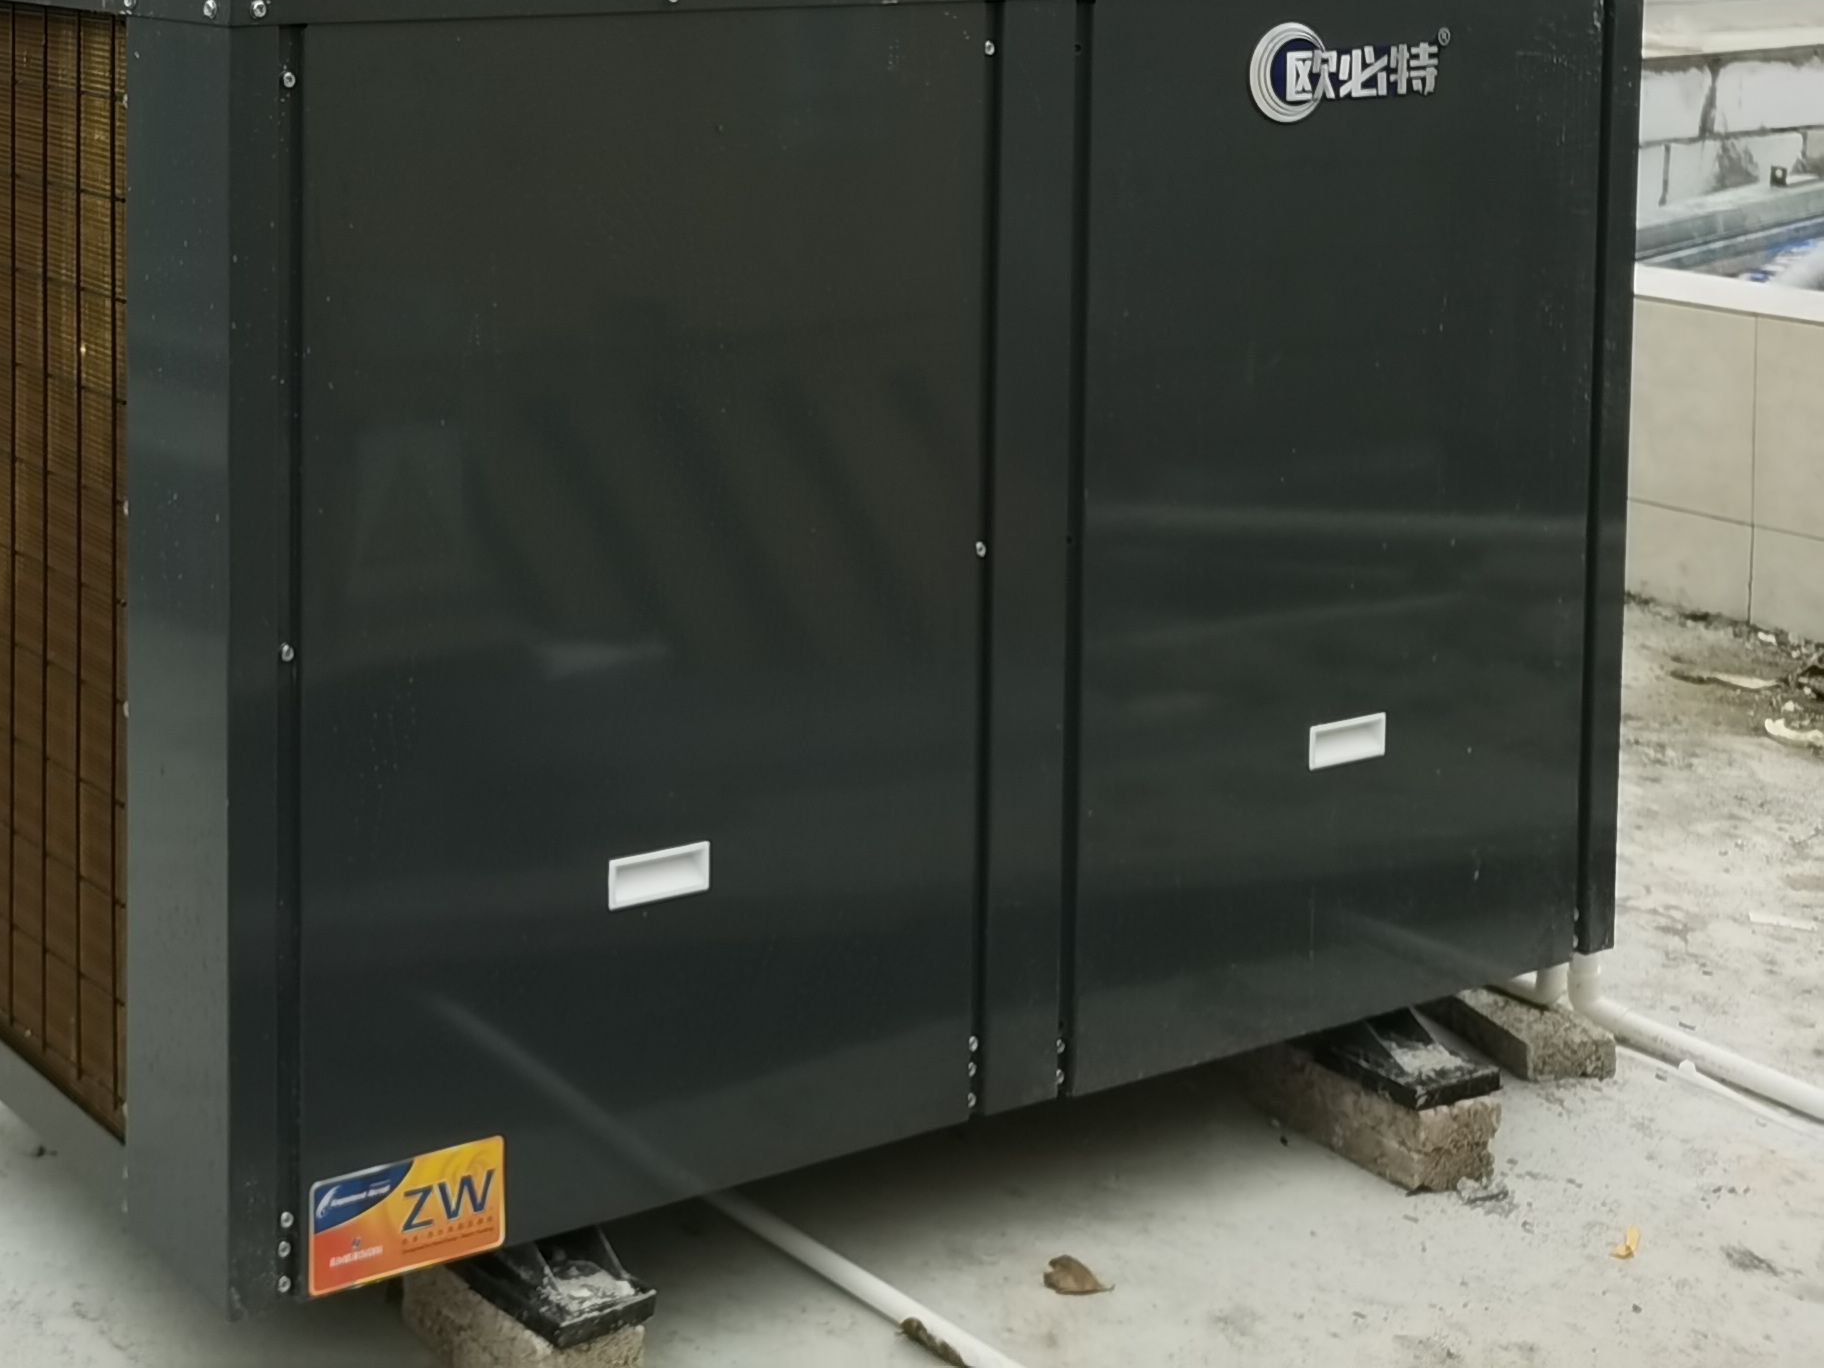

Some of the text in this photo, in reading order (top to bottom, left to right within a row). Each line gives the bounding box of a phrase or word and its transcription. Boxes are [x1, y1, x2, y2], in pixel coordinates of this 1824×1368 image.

[1285, 41, 1439, 102] 欧必特
[401, 1168, 496, 1234] ZW
